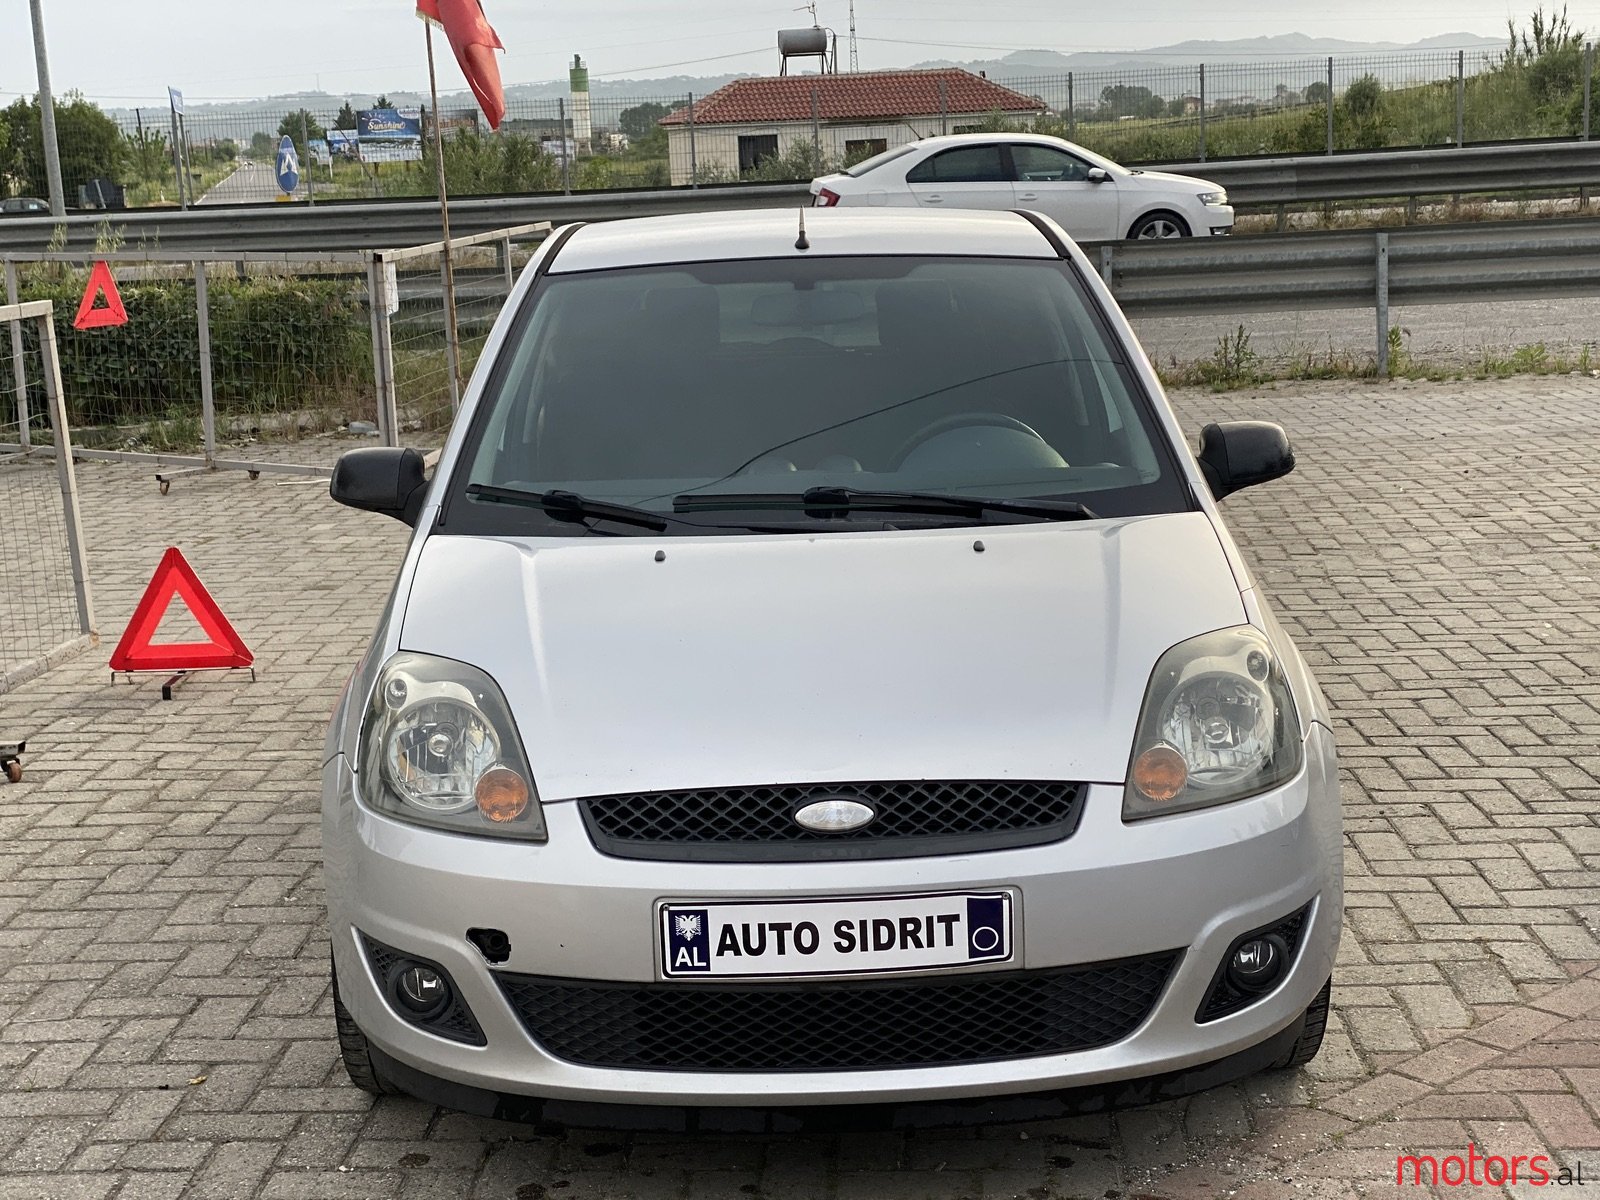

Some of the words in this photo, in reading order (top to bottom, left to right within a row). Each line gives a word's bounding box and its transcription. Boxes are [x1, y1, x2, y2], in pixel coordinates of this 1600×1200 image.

[716, 921, 820, 957] AUTO
[833, 914, 961, 953] SIDRIT
[675, 946, 707, 967] AL
